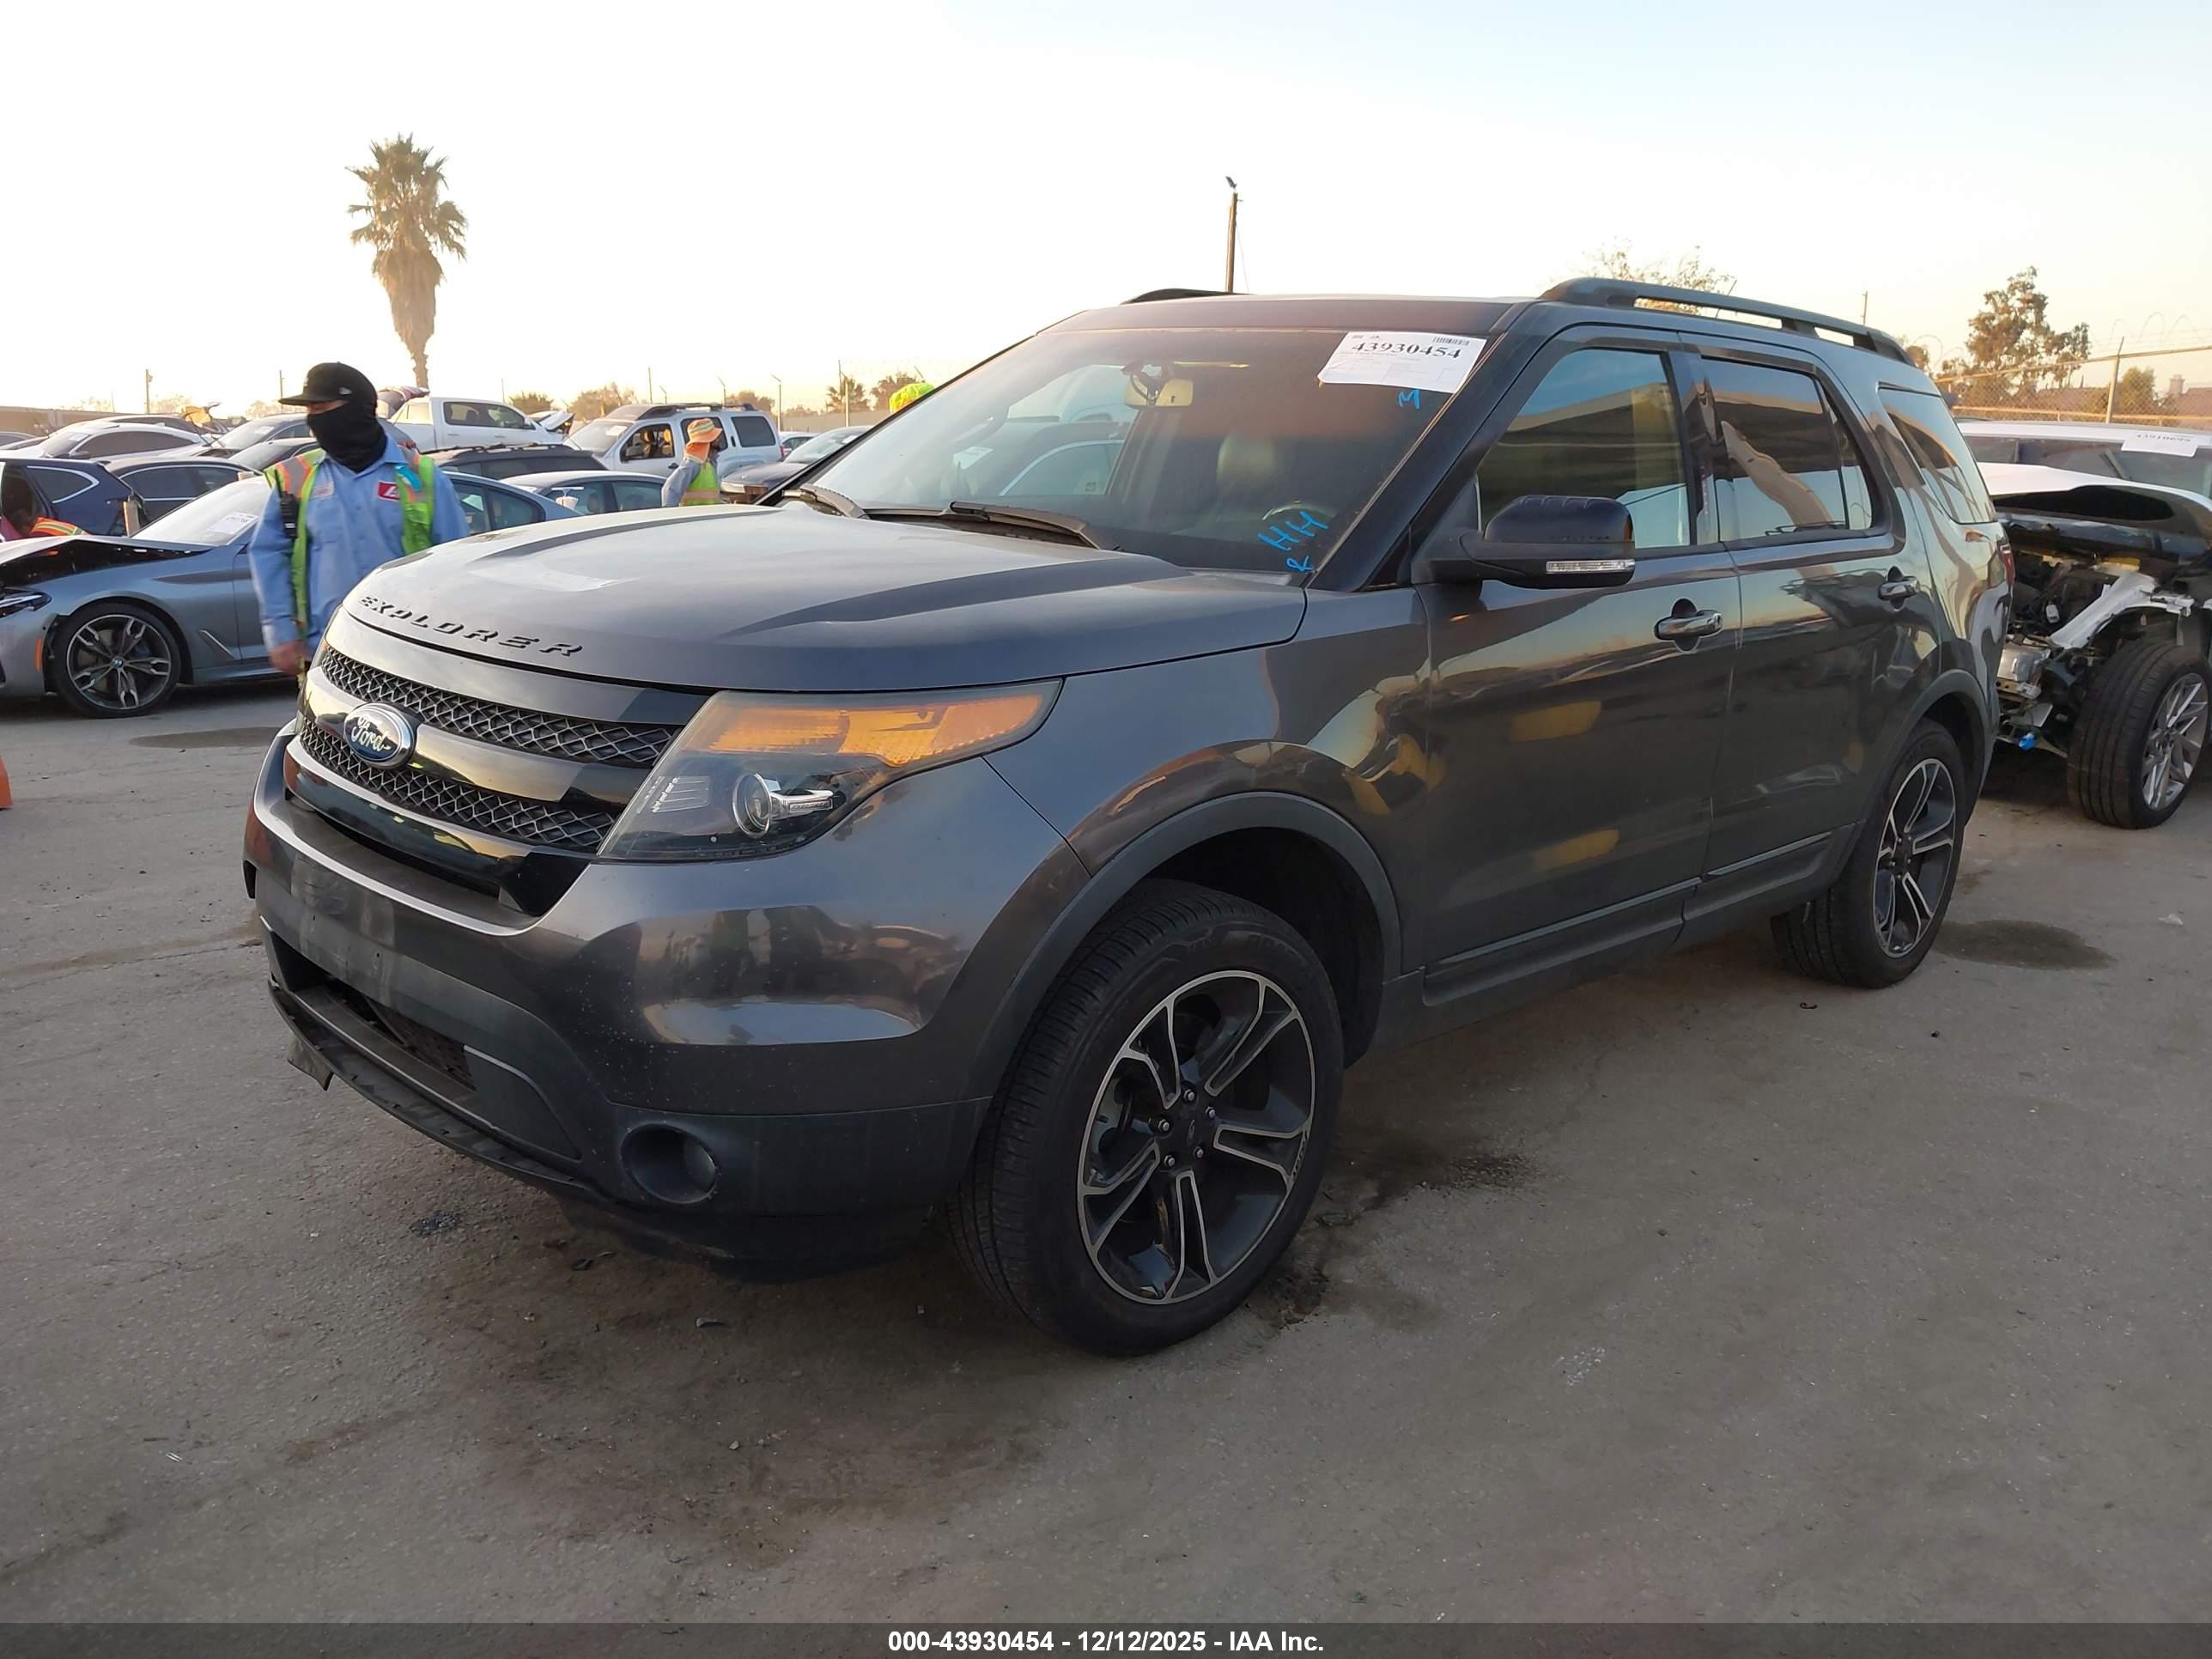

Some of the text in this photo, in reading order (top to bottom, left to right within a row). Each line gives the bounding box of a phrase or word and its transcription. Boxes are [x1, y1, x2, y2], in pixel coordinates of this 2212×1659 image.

[1352, 341, 1462, 360] 43930454
[357, 594, 584, 658] EXPLORER
[350, 714, 392, 752] Ford
